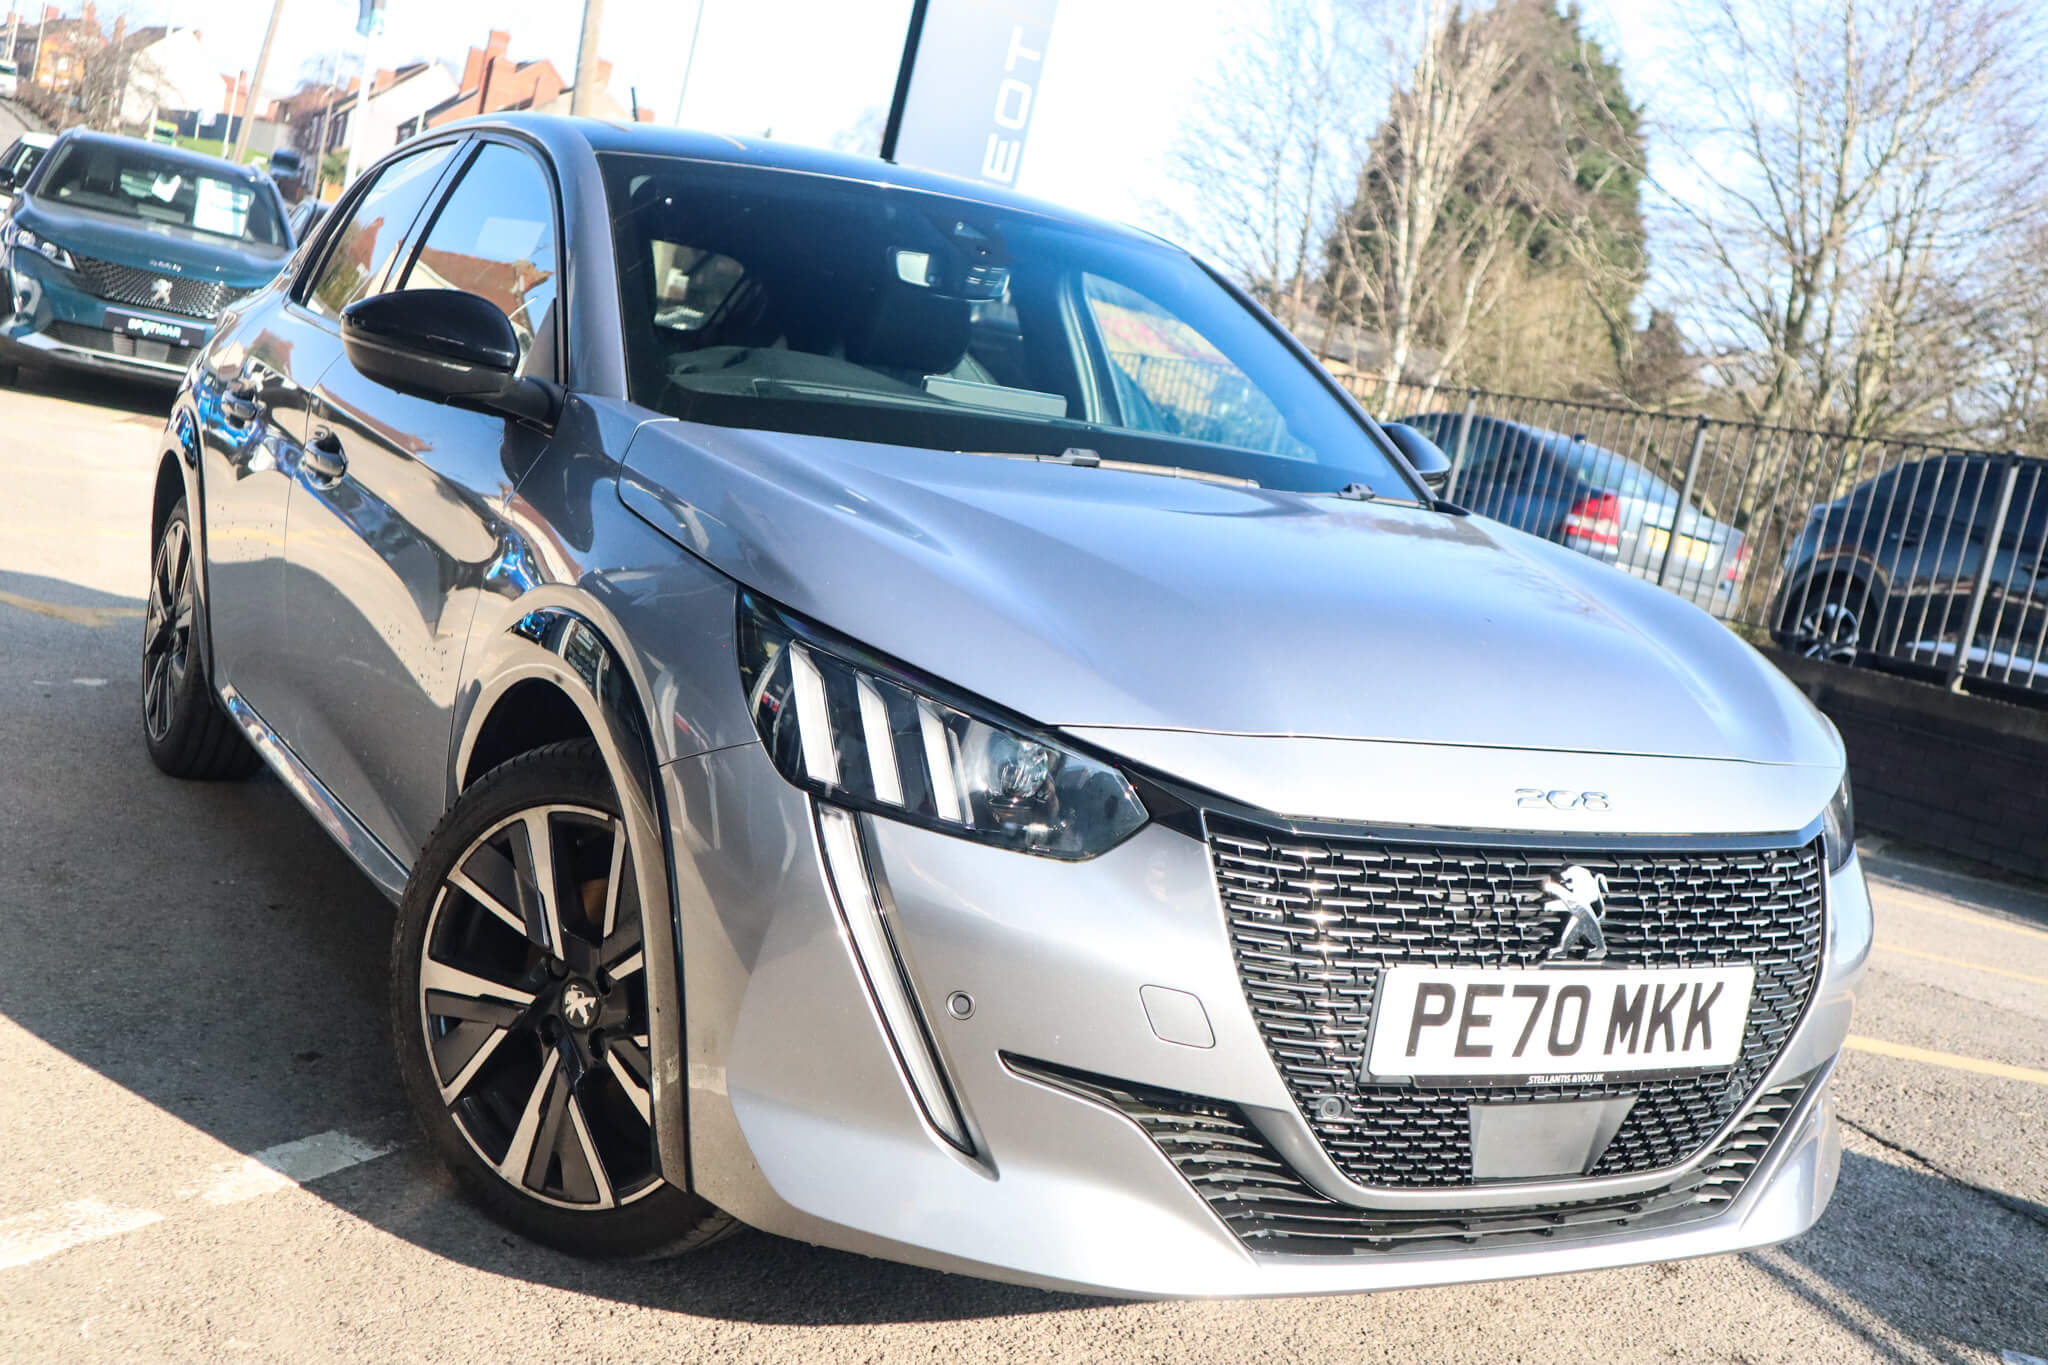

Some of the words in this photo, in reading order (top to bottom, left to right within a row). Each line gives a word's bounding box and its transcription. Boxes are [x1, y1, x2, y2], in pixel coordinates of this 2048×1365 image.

[1514, 787, 1614, 812] 208
[1405, 982, 1592, 1058] PE70
[1603, 981, 1725, 1056] MKK
[1527, 1074, 1571, 1085] STELLANTIS
[1593, 1073, 1605, 1082] UK
